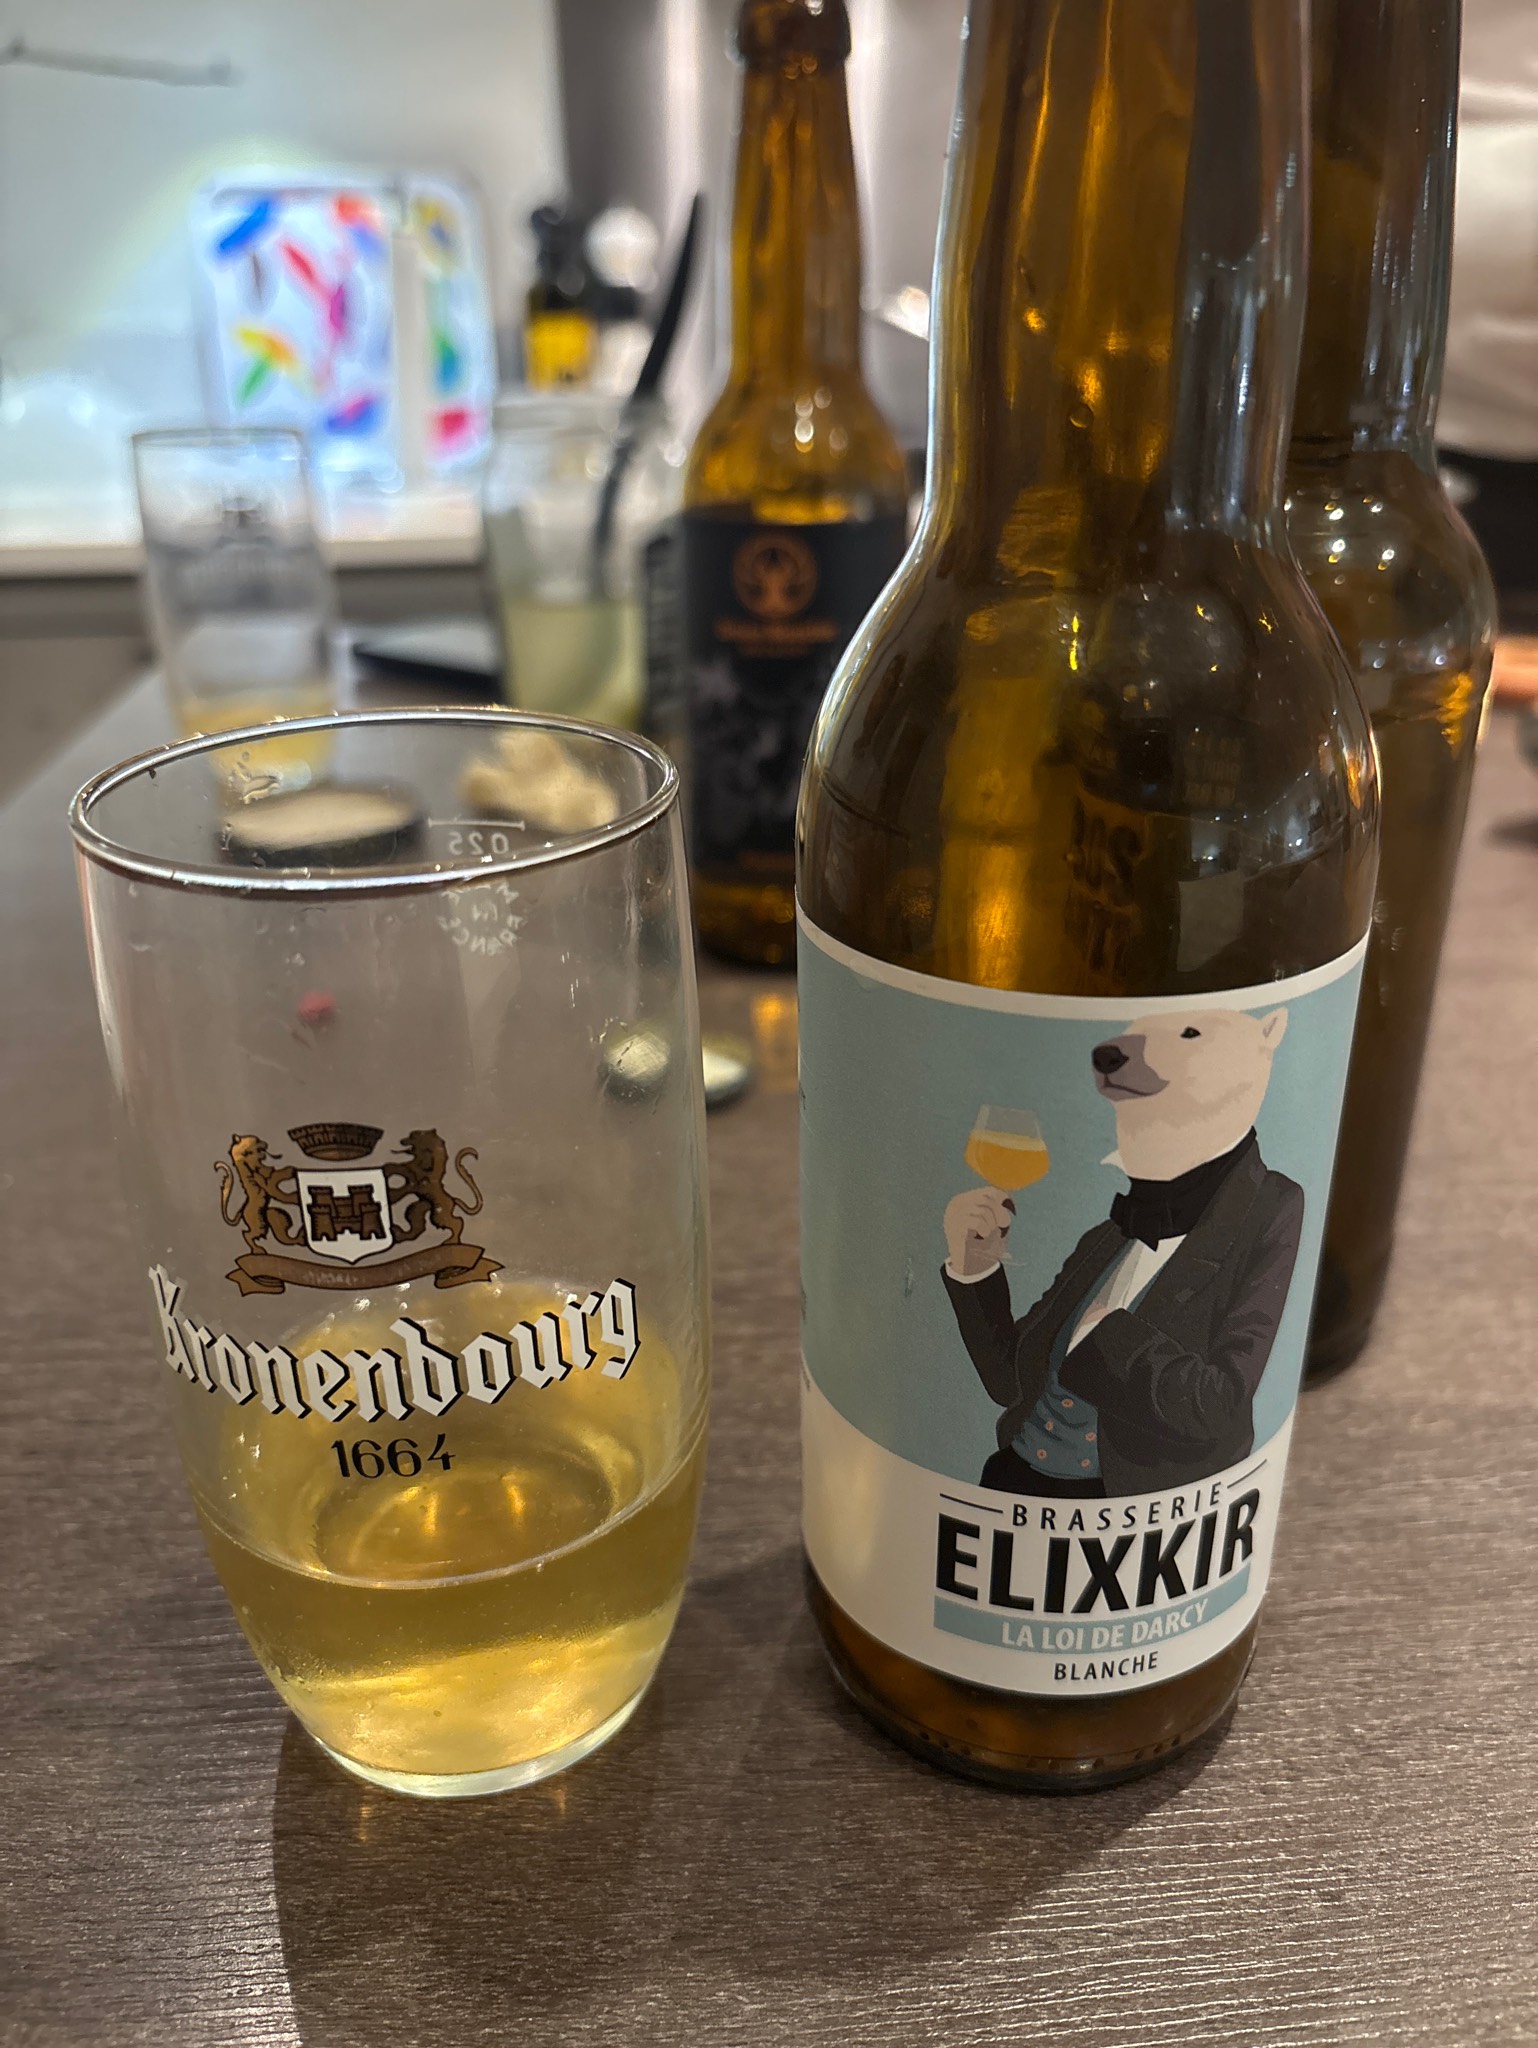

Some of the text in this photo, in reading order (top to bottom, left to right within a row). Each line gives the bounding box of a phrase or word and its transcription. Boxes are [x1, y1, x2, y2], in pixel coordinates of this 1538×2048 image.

[148, 1263, 641, 1422] Kronenbourg
[331, 1433, 457, 1479] 1664
[1012, 1481, 1222, 1531] BRASSERIE
[936, 1488, 1260, 1614] ELIXKIR
[1001, 1598, 1209, 1650] LA LOI DE DARCY
[1054, 1651, 1159, 1681] BLANCHE
